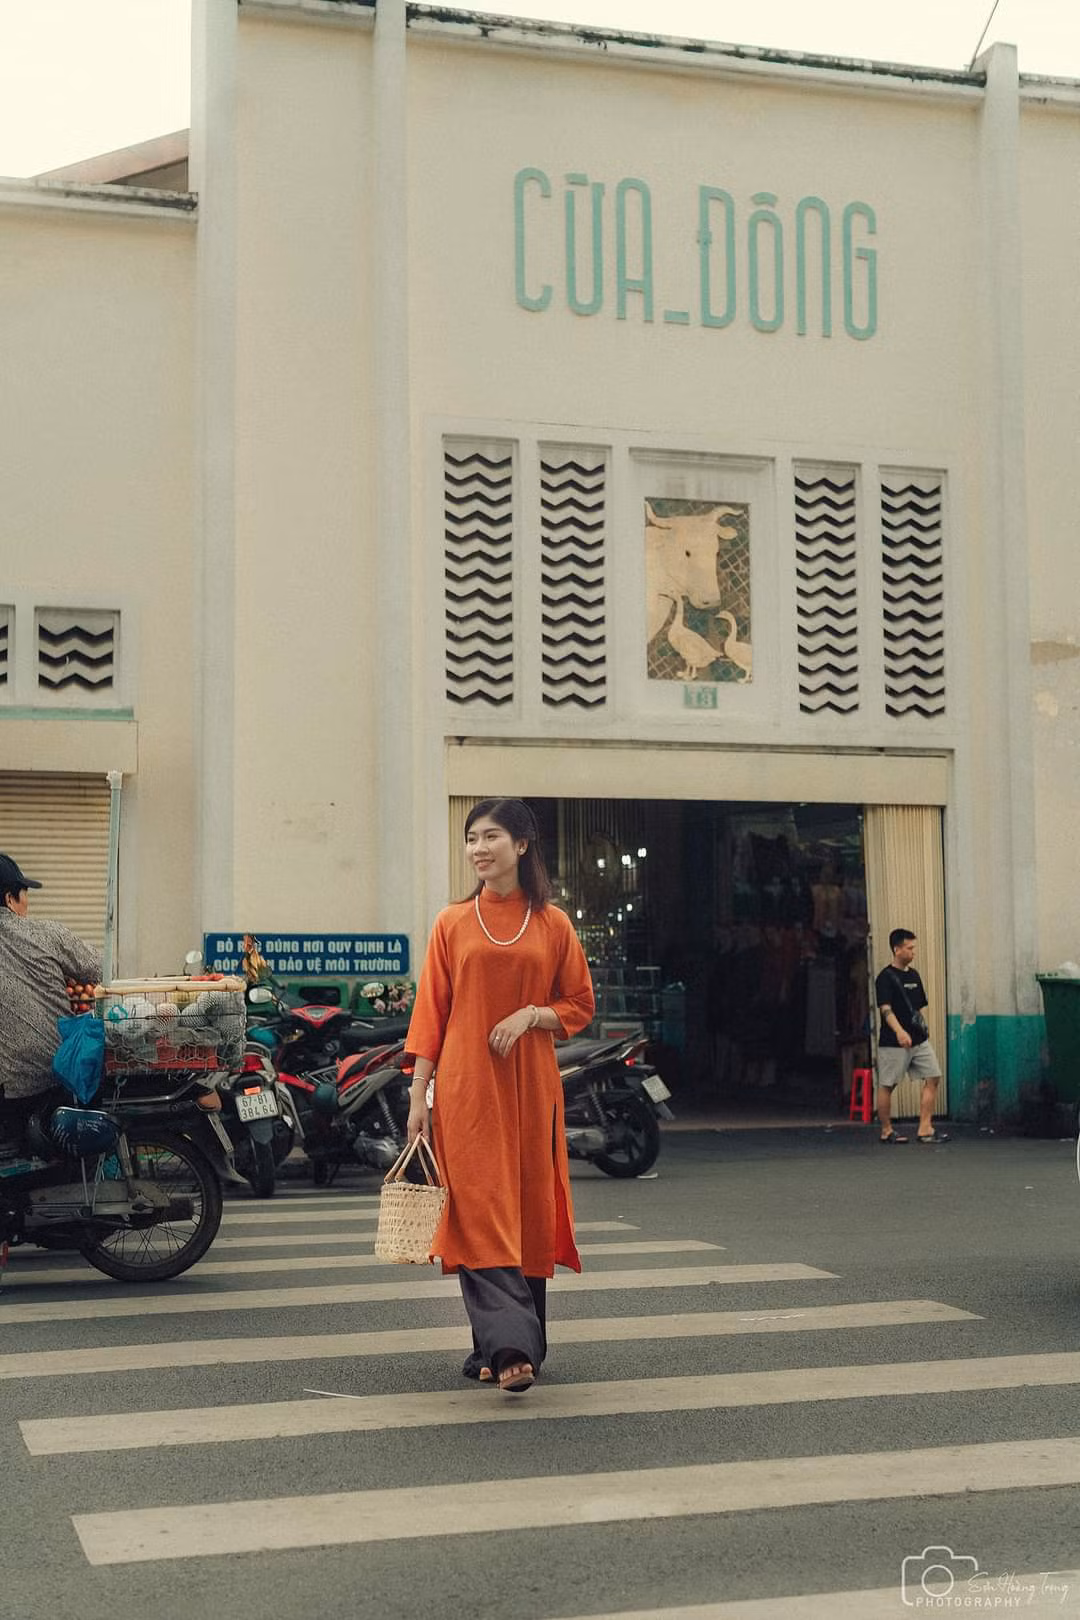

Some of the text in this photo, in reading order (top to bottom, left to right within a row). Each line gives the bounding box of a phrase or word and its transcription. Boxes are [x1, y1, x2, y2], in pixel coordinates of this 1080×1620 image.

[216, 937, 402, 956] BỎ RC ĐÚNG NƠI QUY ĐỊNH LÀ
[278, 956, 303, 971] BẢO
[306, 957, 322, 974] VỆ
[325, 957, 350, 971] MÔI
[354, 957, 401, 972] TRƯỜNG
